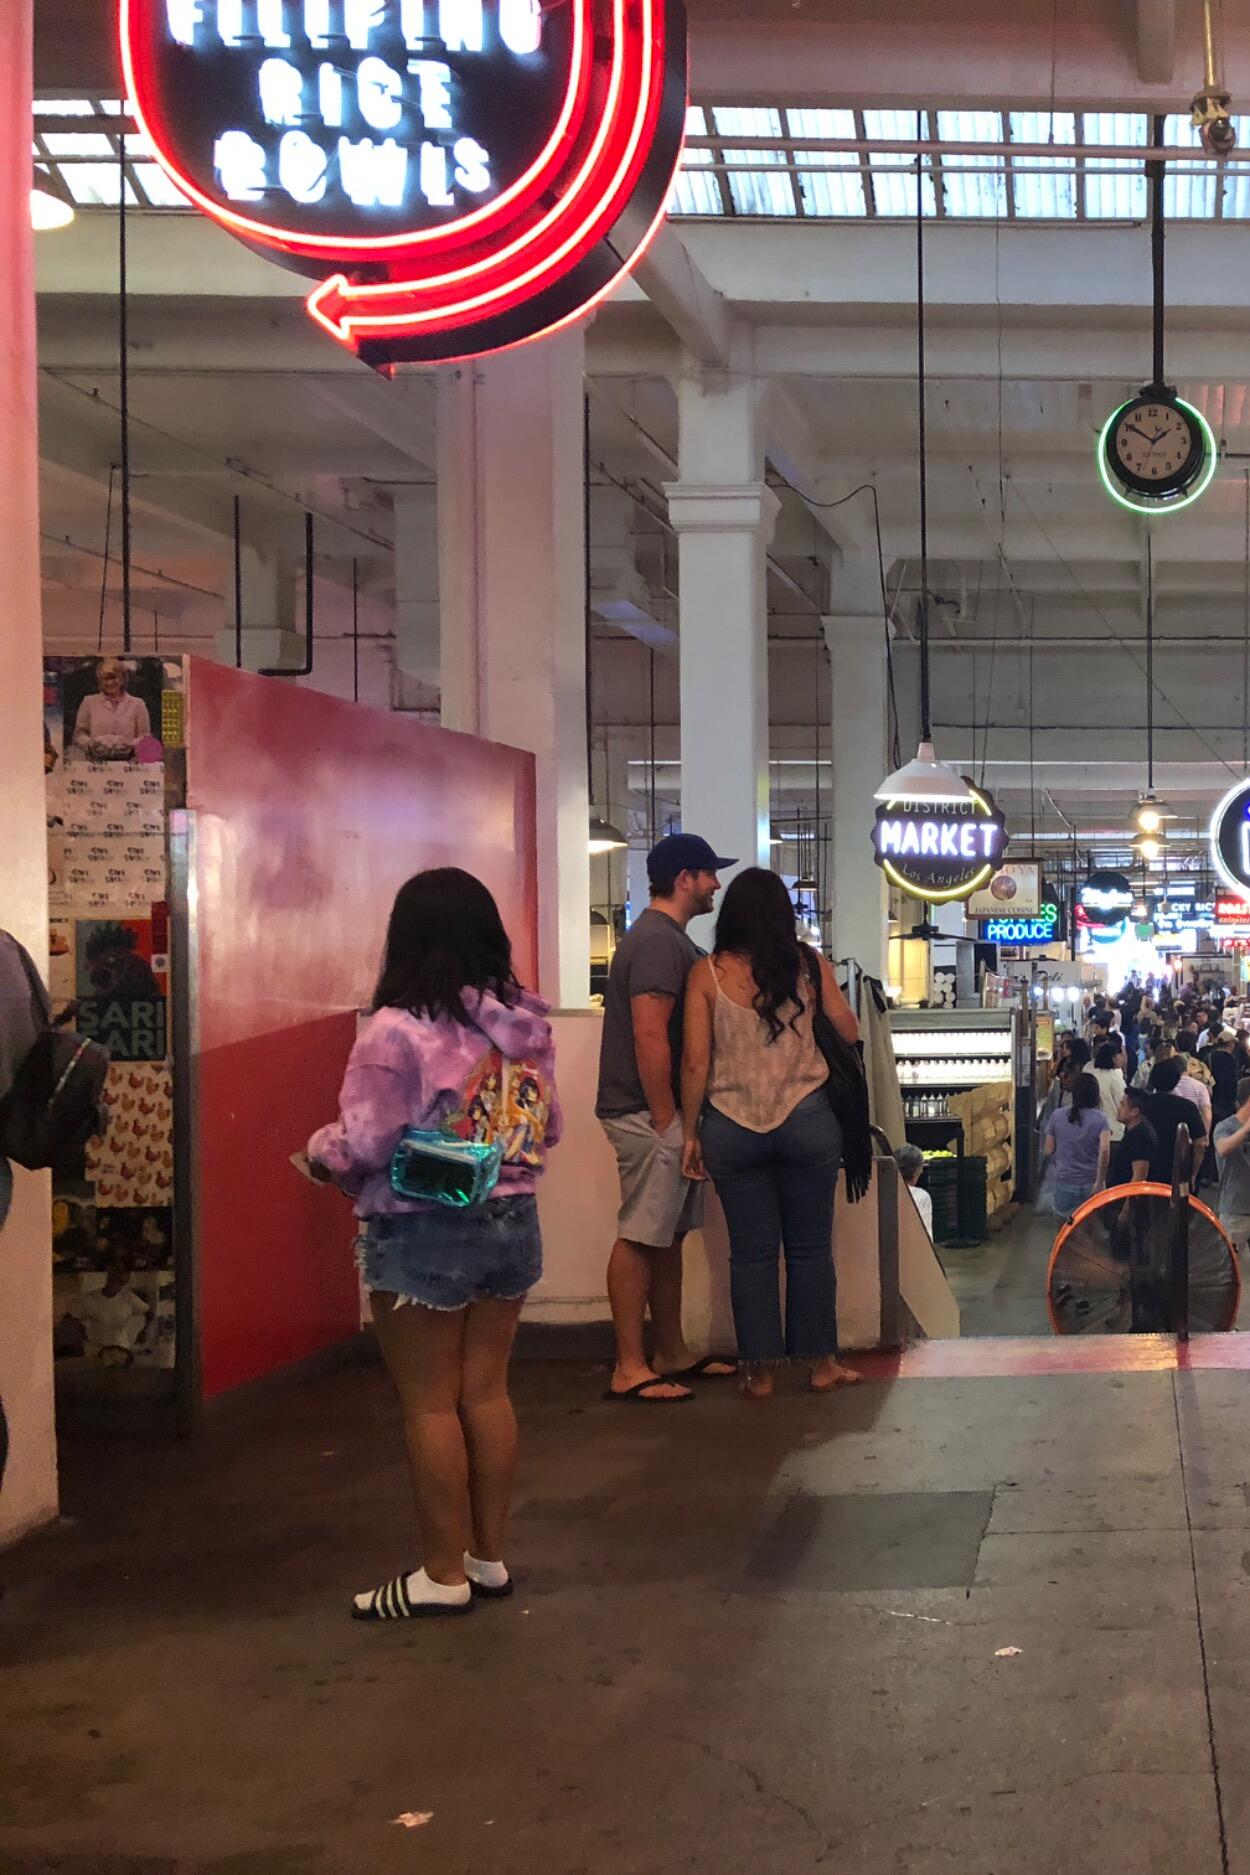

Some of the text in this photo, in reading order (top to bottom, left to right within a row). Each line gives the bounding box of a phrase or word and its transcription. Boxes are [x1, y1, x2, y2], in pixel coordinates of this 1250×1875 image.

[258, 56, 456, 129] RICE
[213, 130, 491, 205] BOWLS
[903, 800, 976, 815] DISTRICT
[881, 820, 998, 857] MARKET
[903, 864, 976, 887] Los Angeles
[1156, 902, 1192, 912] SCKY
[988, 923, 1053, 940] PRODUCE
[80, 1001, 164, 1028] SARI
[84, 1029, 164, 1056] ARI
